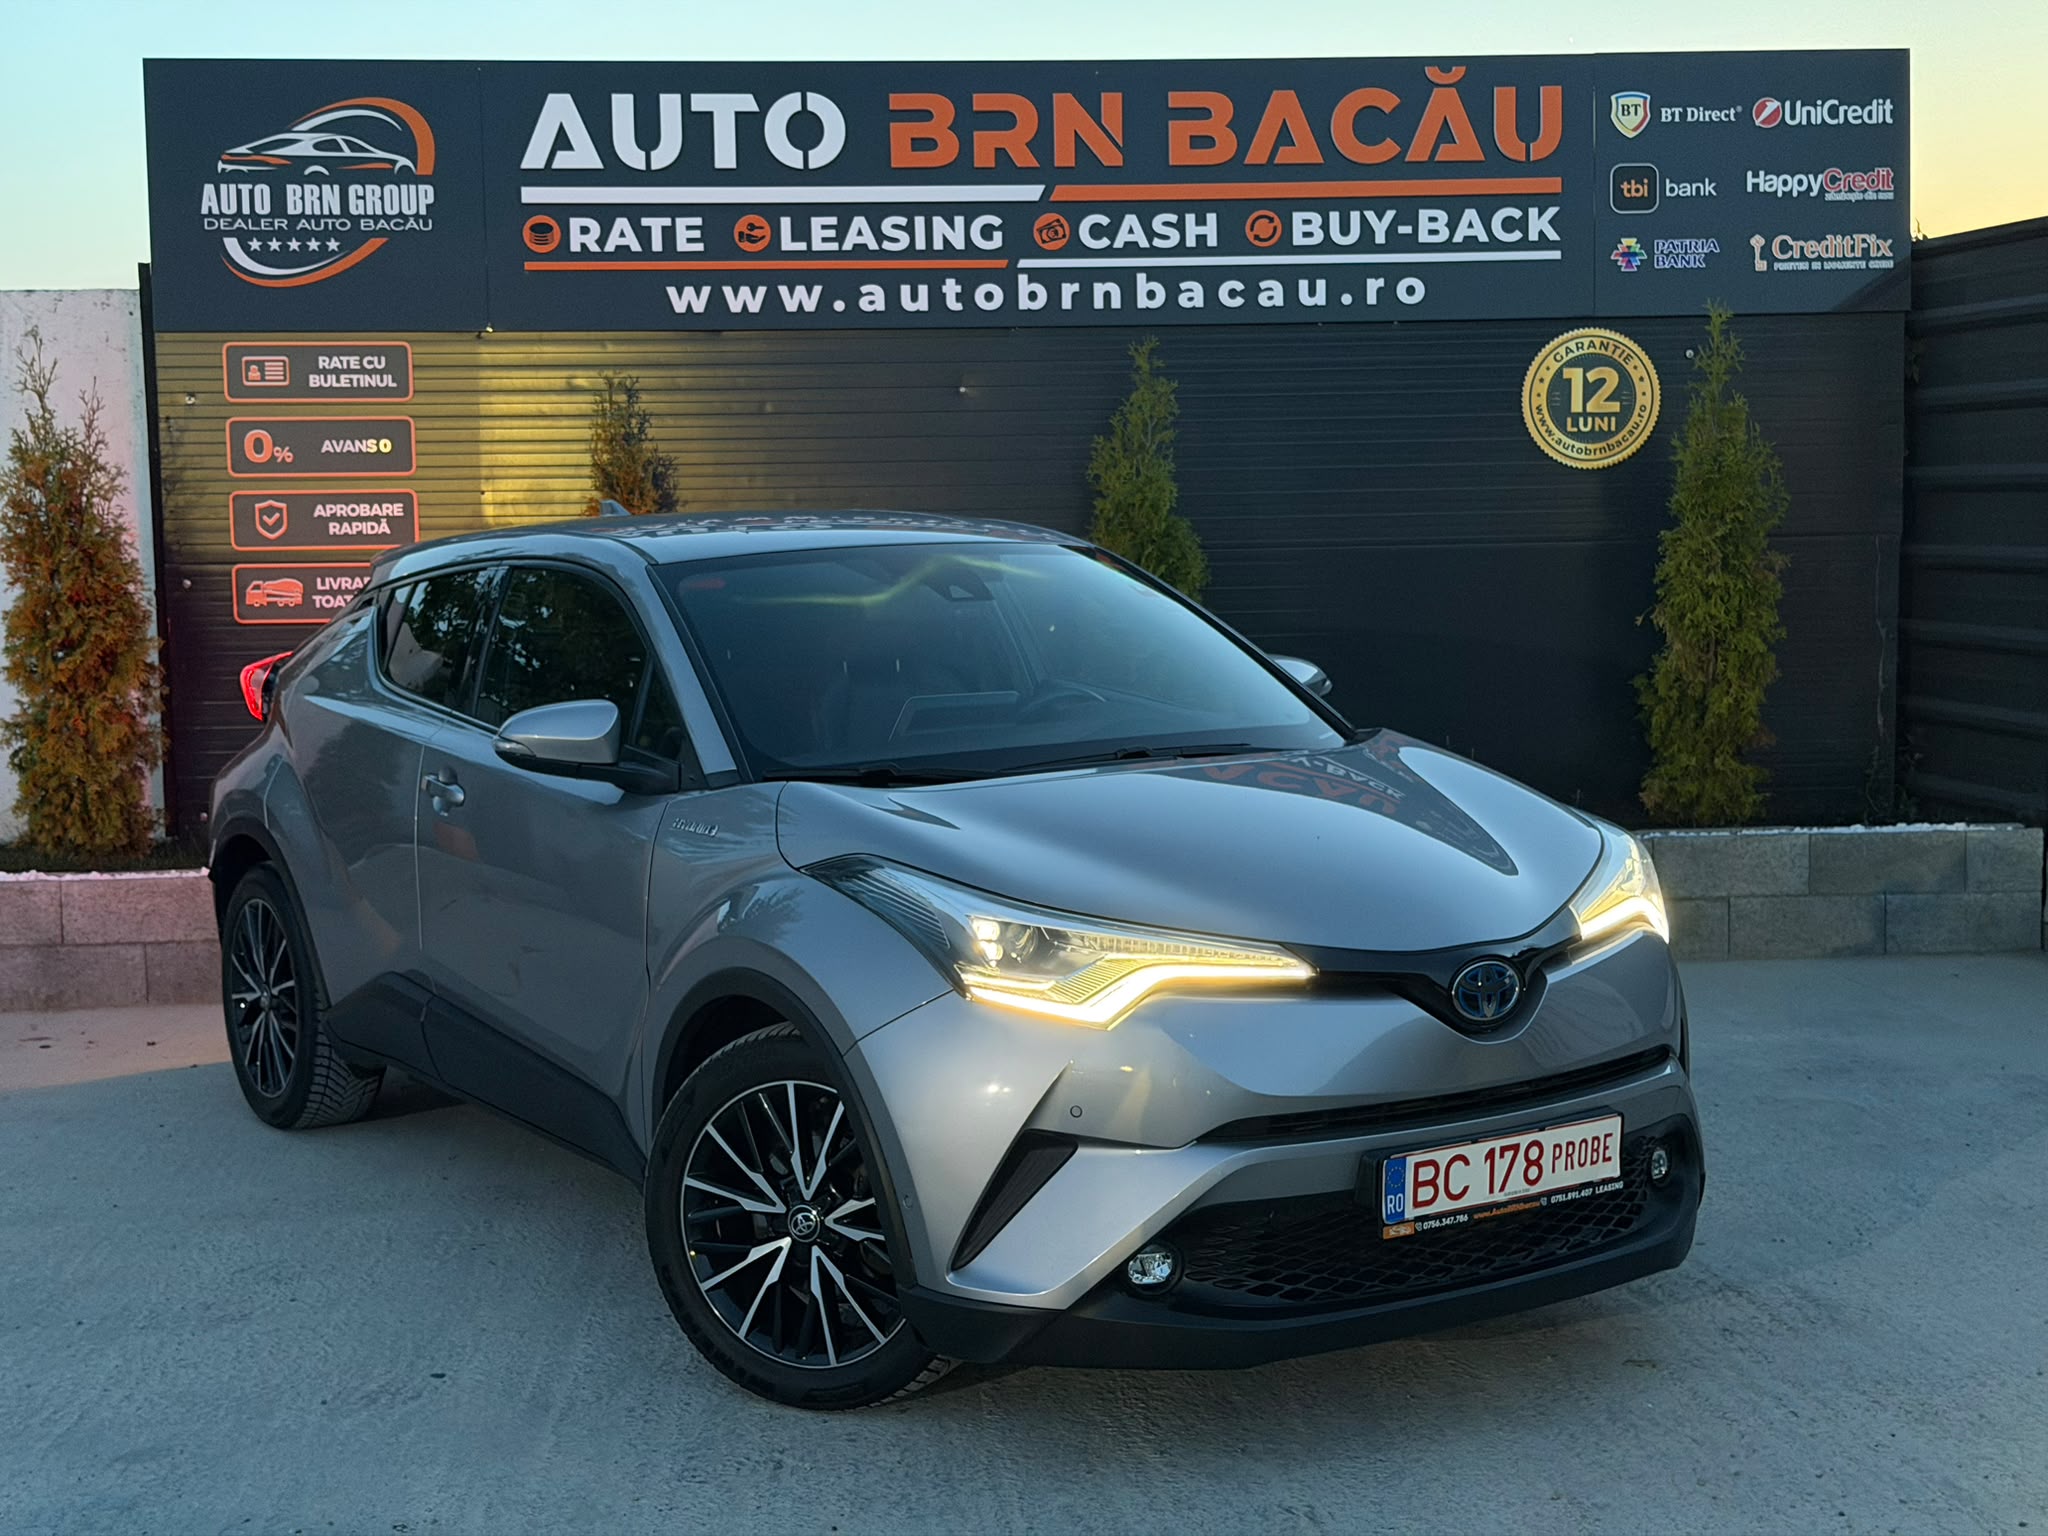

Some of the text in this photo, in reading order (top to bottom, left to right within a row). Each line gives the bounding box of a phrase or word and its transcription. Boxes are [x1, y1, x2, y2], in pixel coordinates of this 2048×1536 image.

[519, 65, 1563, 171] AUTO BRN BACĂU
[1620, 103, 1642, 117] BT
[1660, 107, 1683, 122] BT
[1784, 98, 1894, 126] UniCredit
[1620, 178, 1649, 198] tbi
[1665, 177, 1718, 197] bank
[1746, 167, 1895, 198] HappyCredit
[201, 183, 435, 217] AUTO BRN GROUP
[203, 215, 433, 231] DEALER AUTO BACĂU
[568, 206, 1562, 253] RATE LEASING CASH BUY-BACK
[1654, 237, 1721, 254] PATRIA
[1771, 233, 1894, 260] CreditFix
[1654, 253, 1706, 269] BANK
[665, 273, 1426, 314] www.autobrnbacau.ro
[317, 355, 386, 370] RATE CU
[1552, 339, 1634, 366] GARANTIE
[308, 373, 398, 389] BULETINUL
[1562, 366, 1621, 414] 12
[1566, 416, 1617, 433] LUNI
[243, 428, 294, 464] 0%
[313, 503, 405, 518] APROBARE
[328, 518, 392, 536] RAPIDĂ
[1411, 1132, 1614, 1210] BC 178 PROBE
[1595, 1180, 1625, 1195] LEASING
[1386, 1193, 1404, 1216] RO
